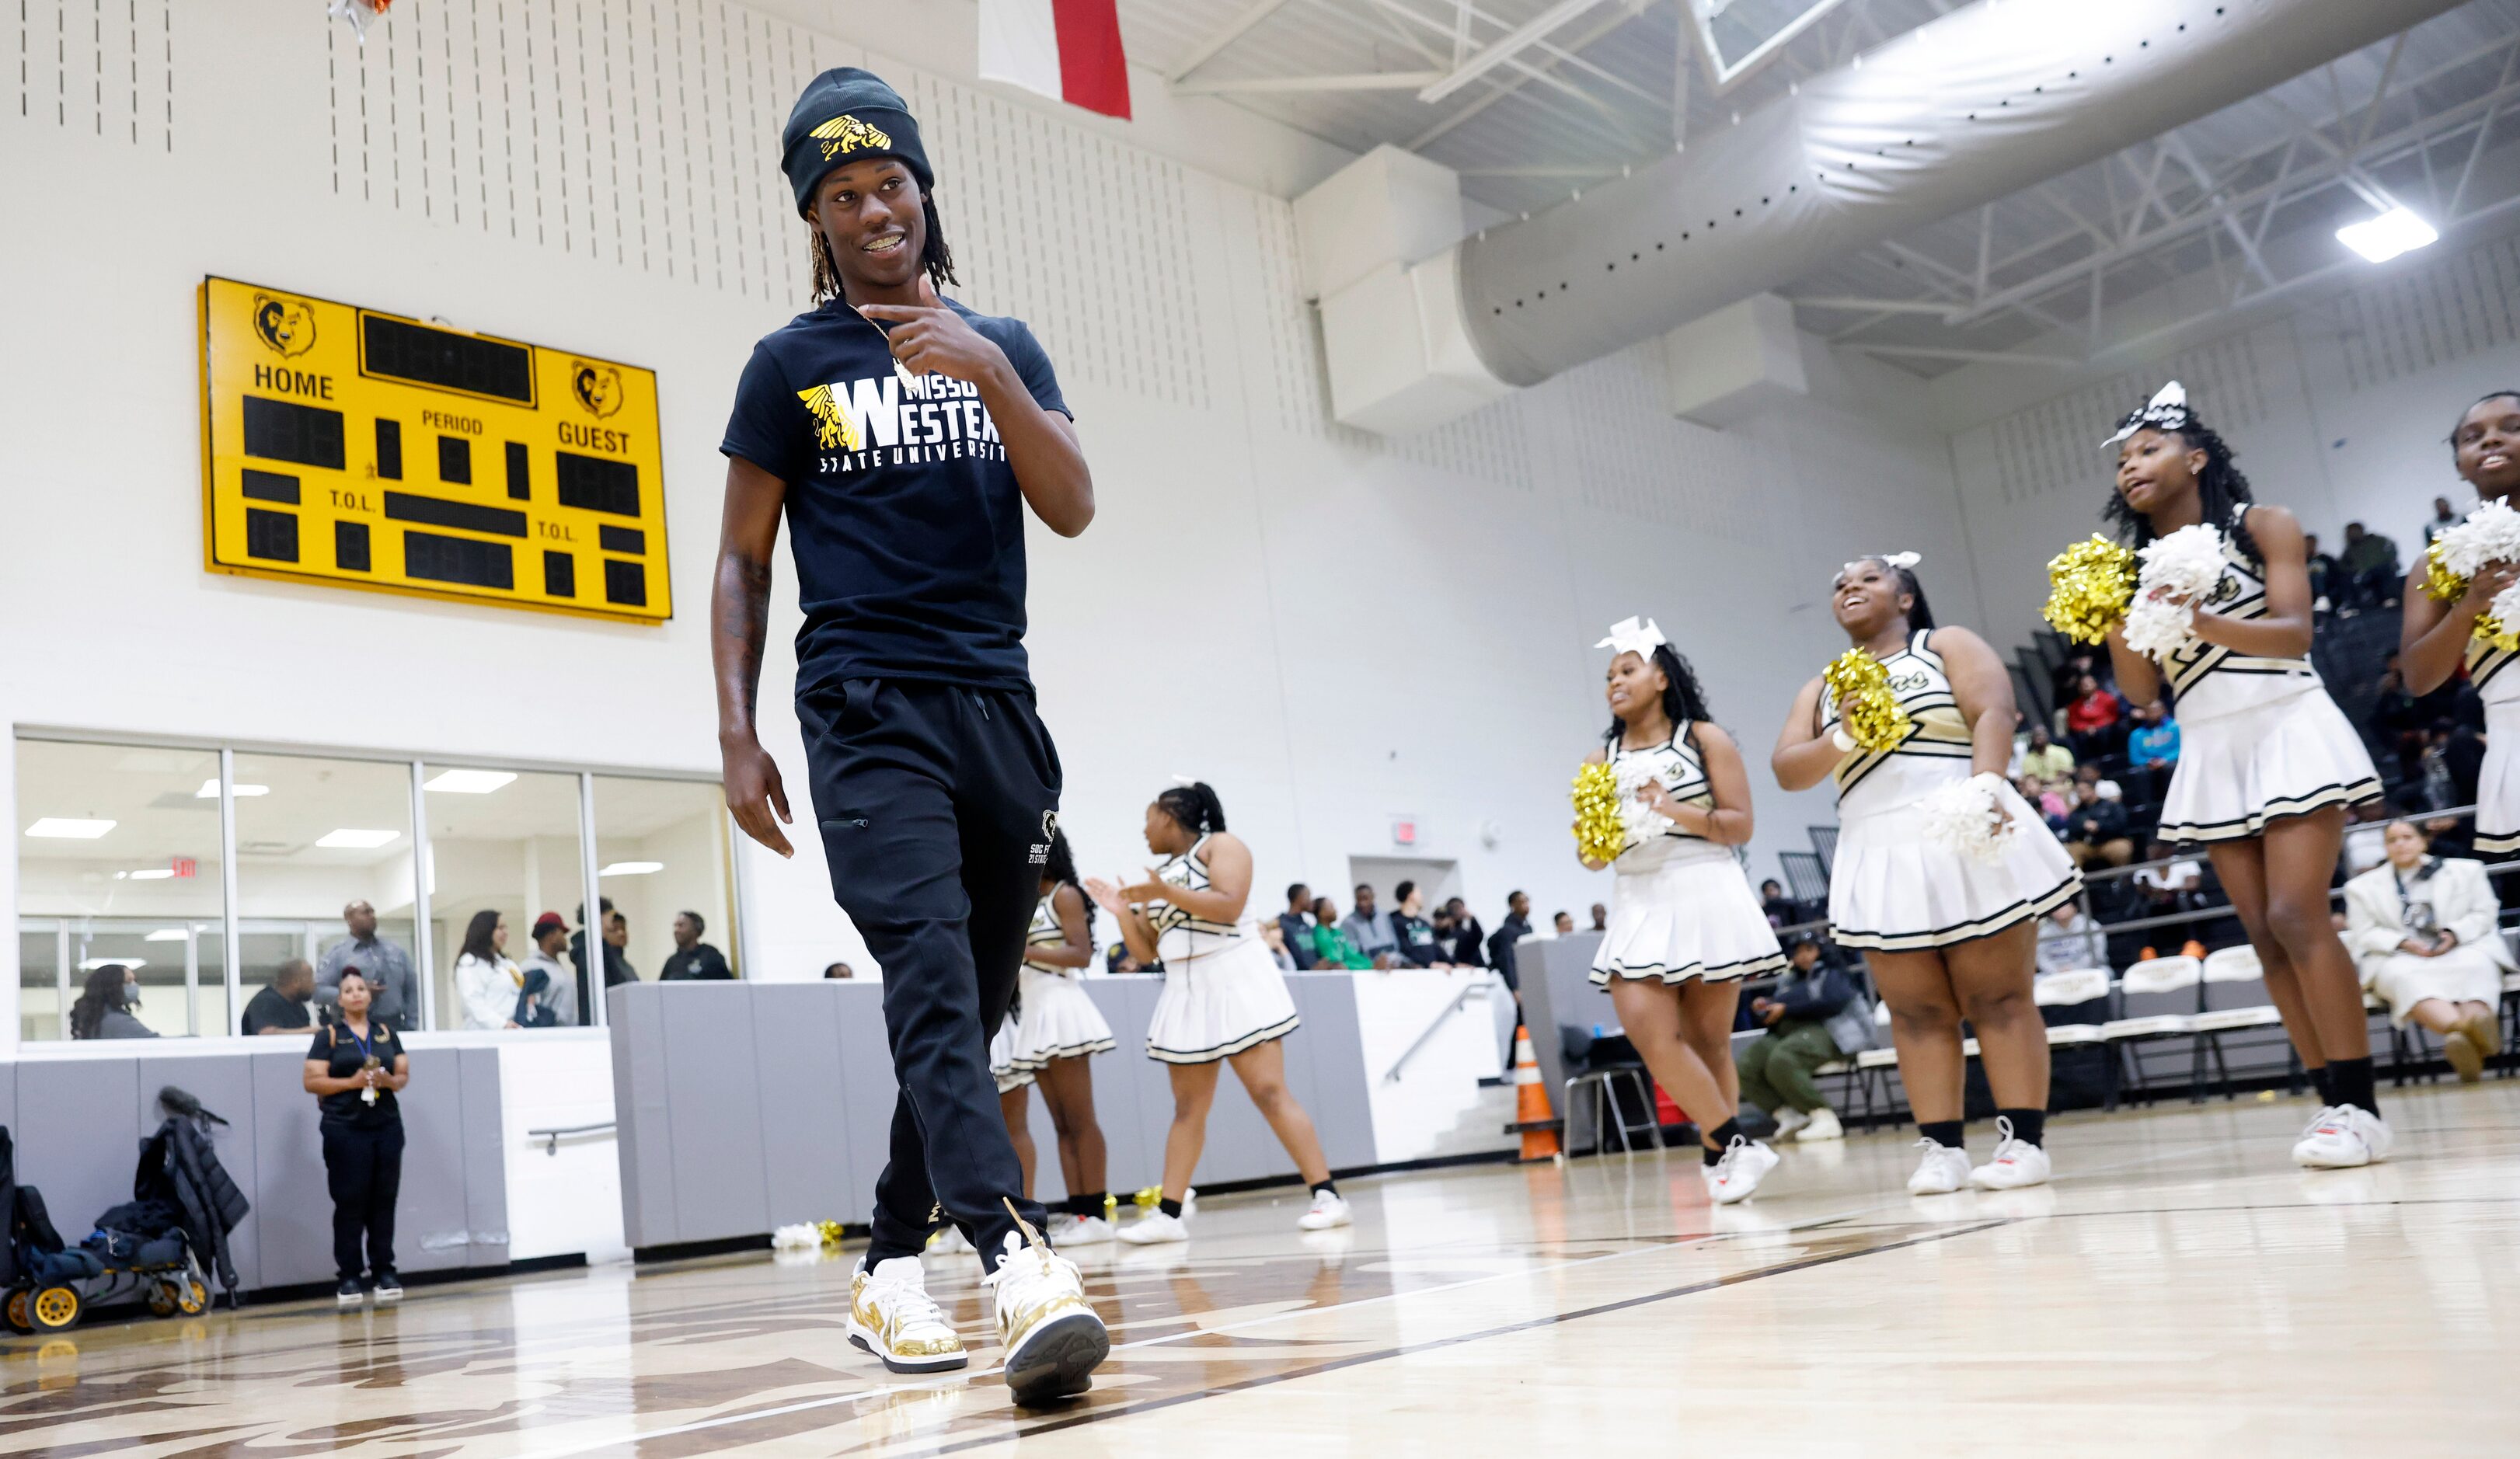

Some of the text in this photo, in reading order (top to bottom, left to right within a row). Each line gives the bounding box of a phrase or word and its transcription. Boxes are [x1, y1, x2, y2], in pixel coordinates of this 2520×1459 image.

[255, 364, 334, 402] HOME
[905, 374, 978, 400] MISSO
[422, 409, 483, 436] PERIOD
[830, 375, 1000, 452] WESTER
[558, 421, 630, 454] GUEST
[820, 440, 1005, 472] STATE UNIVERSIT
[329, 489, 377, 514] T.O.L.
[537, 521, 579, 543] T.O.L.
[1028, 854, 1034, 864] 21
[1030, 844, 1044, 854] SOC
